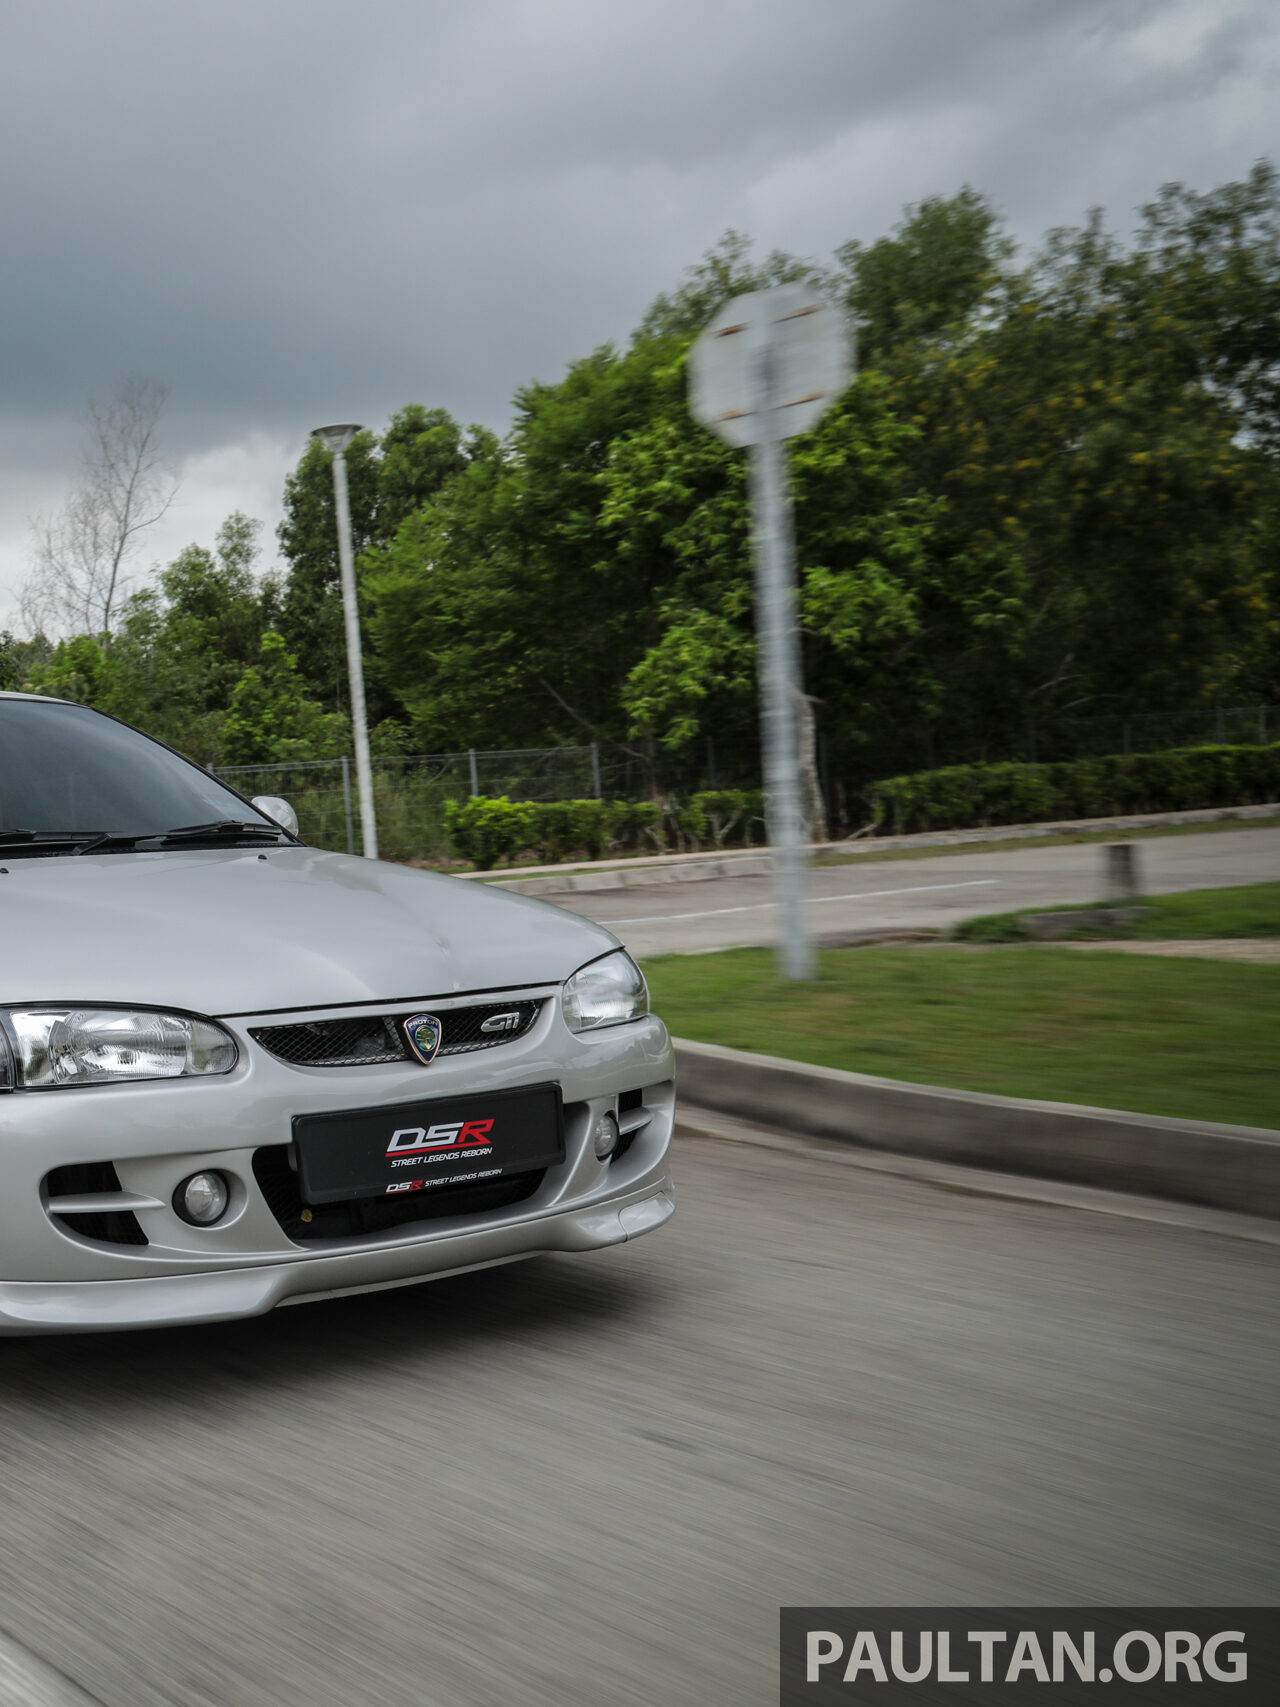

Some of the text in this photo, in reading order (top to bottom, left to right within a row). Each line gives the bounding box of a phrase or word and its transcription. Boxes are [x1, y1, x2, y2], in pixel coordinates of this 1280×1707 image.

[407, 1019, 439, 1029] PROTON
[385, 1119, 495, 1154] DSR
[390, 1147, 493, 1168] STREET LEGENDS REBORN
[385, 1168, 503, 1193] DSR STREET LEGENDS REBORN
